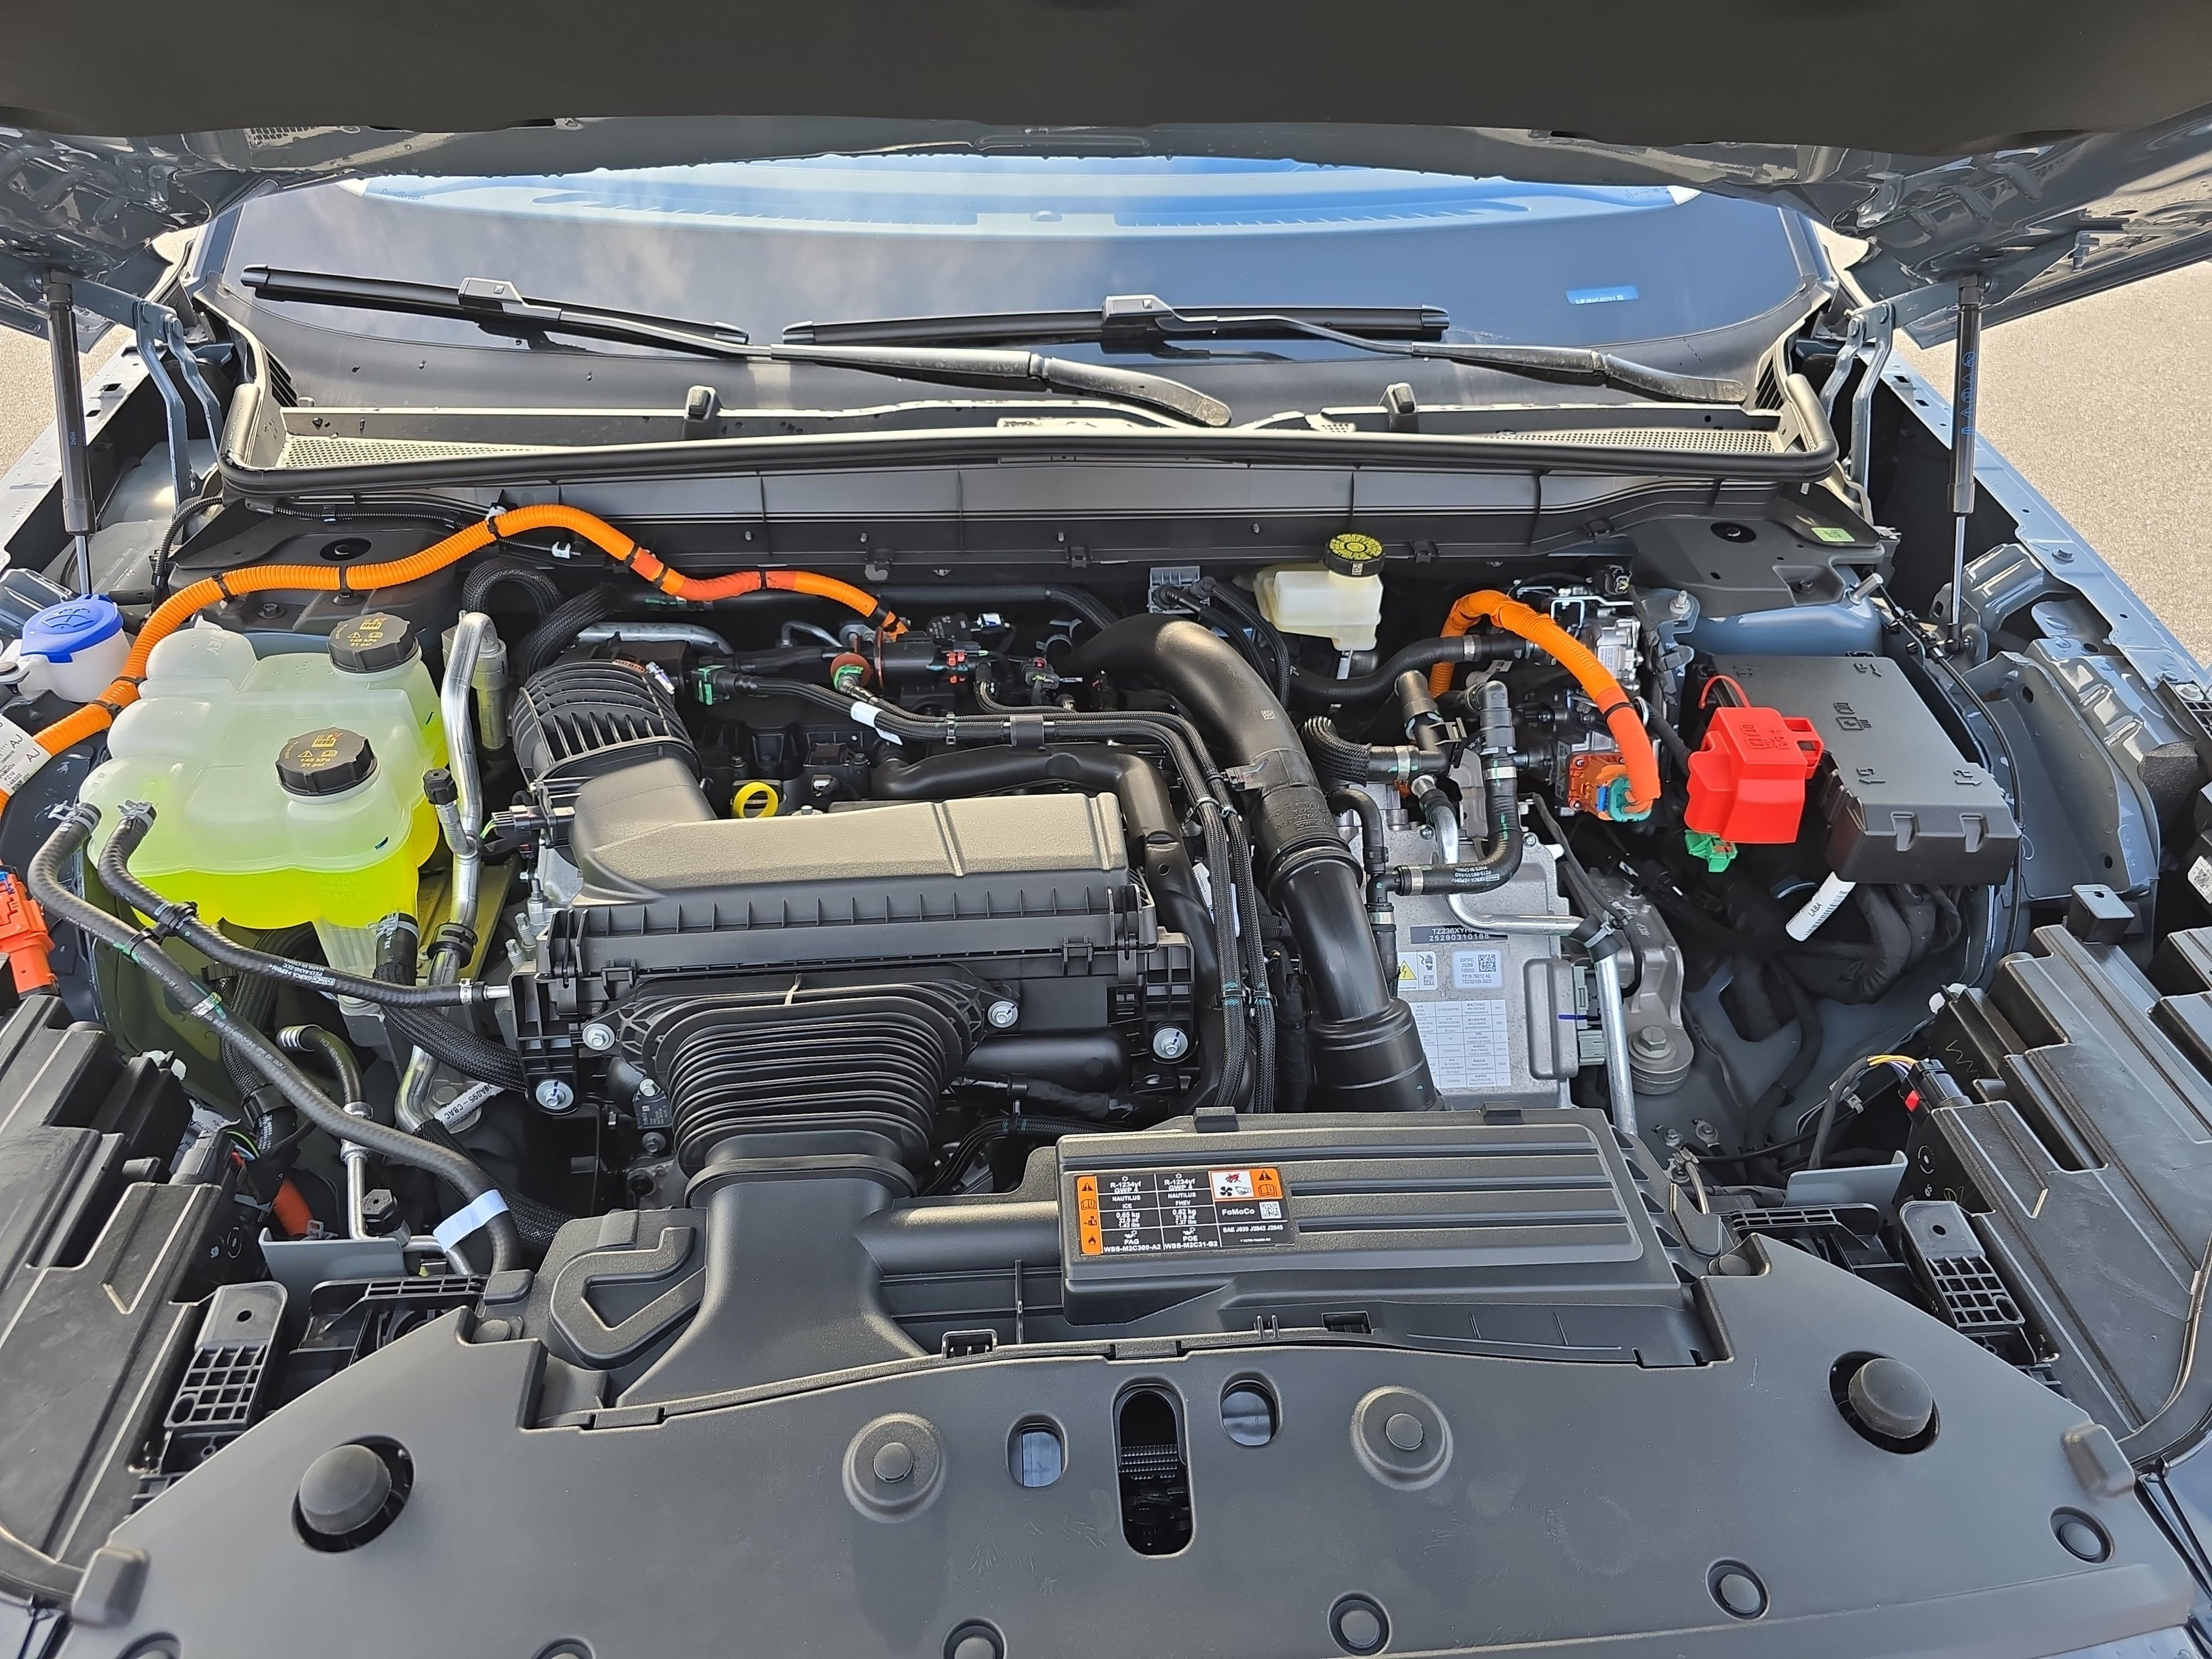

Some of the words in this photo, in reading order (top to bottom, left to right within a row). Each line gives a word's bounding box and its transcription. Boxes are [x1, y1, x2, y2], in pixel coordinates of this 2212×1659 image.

[26, 748, 40, 763] AJ
[1429, 934, 1489, 942] 25290310188
[1110, 1181, 1141, 1191] R-1234yf
[1165, 1178, 1195, 1188] R-1234yf
